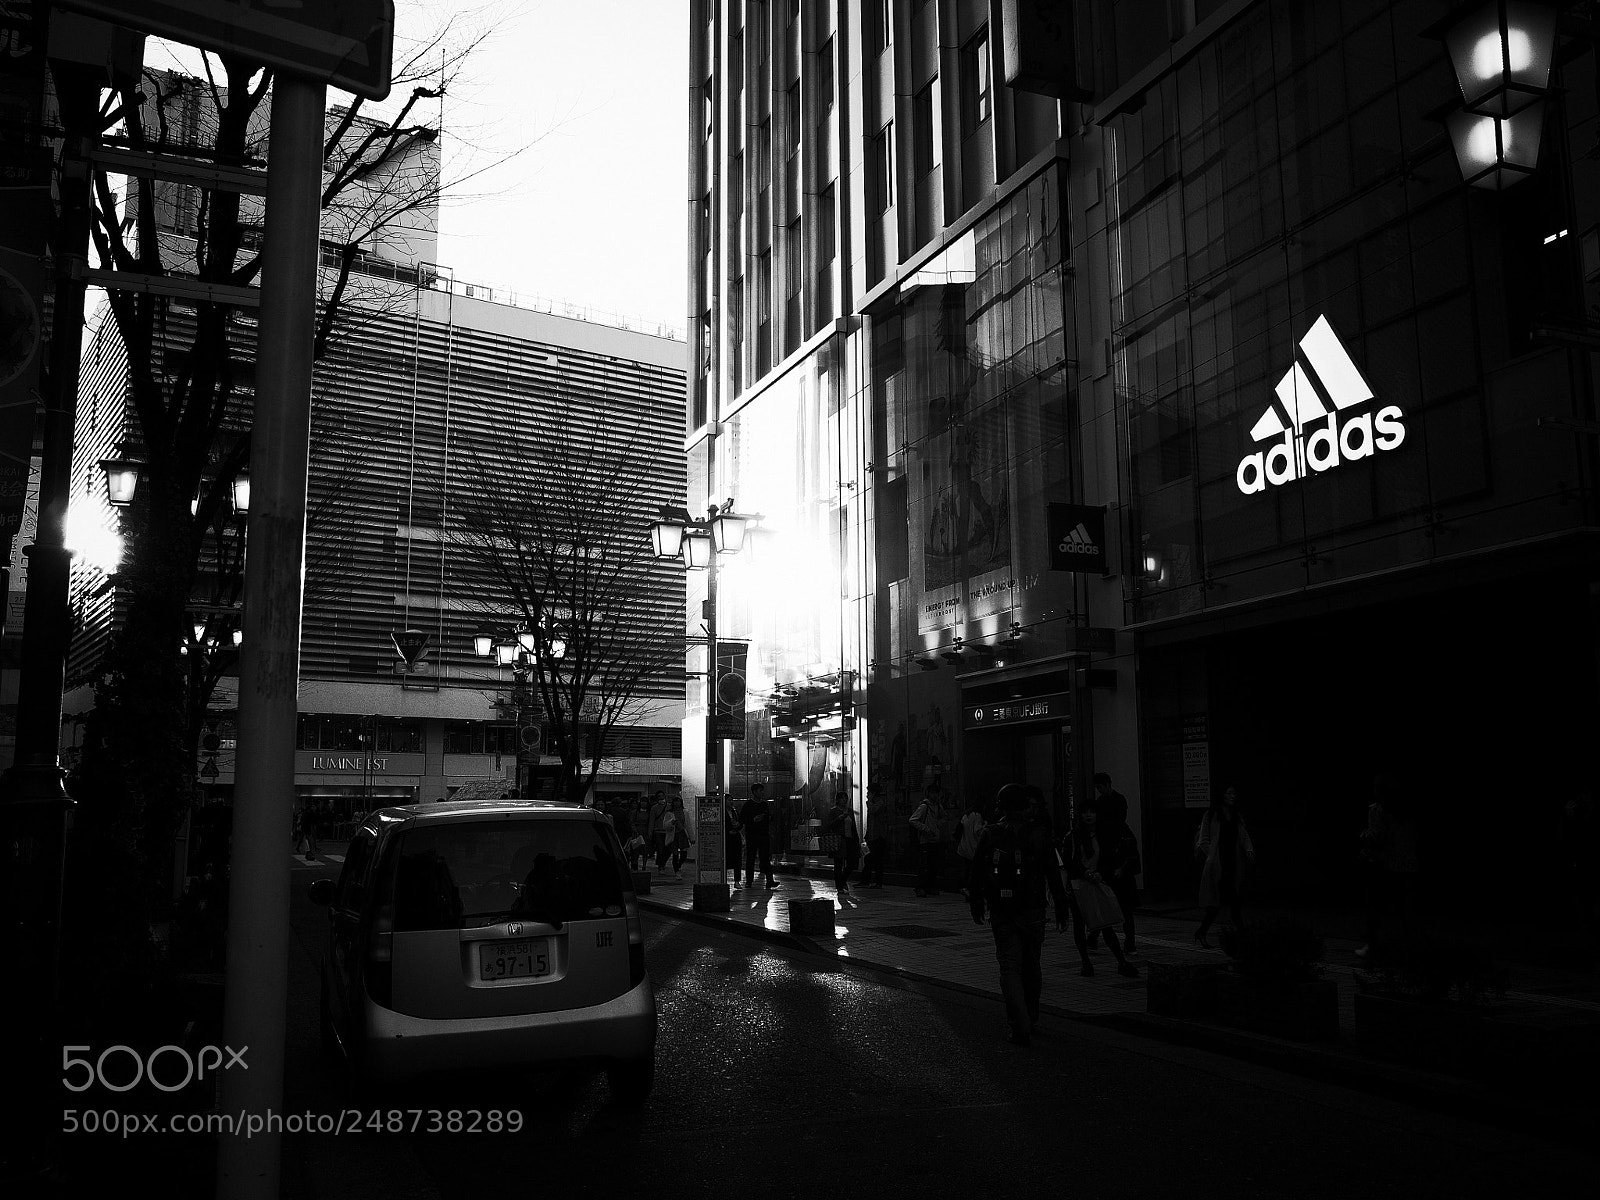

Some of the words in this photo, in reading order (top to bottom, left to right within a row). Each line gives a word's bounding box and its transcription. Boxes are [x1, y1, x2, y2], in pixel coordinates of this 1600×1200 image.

[1236, 405, 1406, 495] adidas
[1058, 542, 1100, 555] adidas
[970, 590, 981, 600] THE
[1007, 579, 1016, 589] UP
[925, 601, 944, 613] ENERGY
[945, 597, 960, 608] FROM
[400, 638, 422, 646] 止まれ
[313, 756, 362, 770] LUMINE
[367, 758, 389, 770] EST
[495, 954, 547, 976] 97-15
